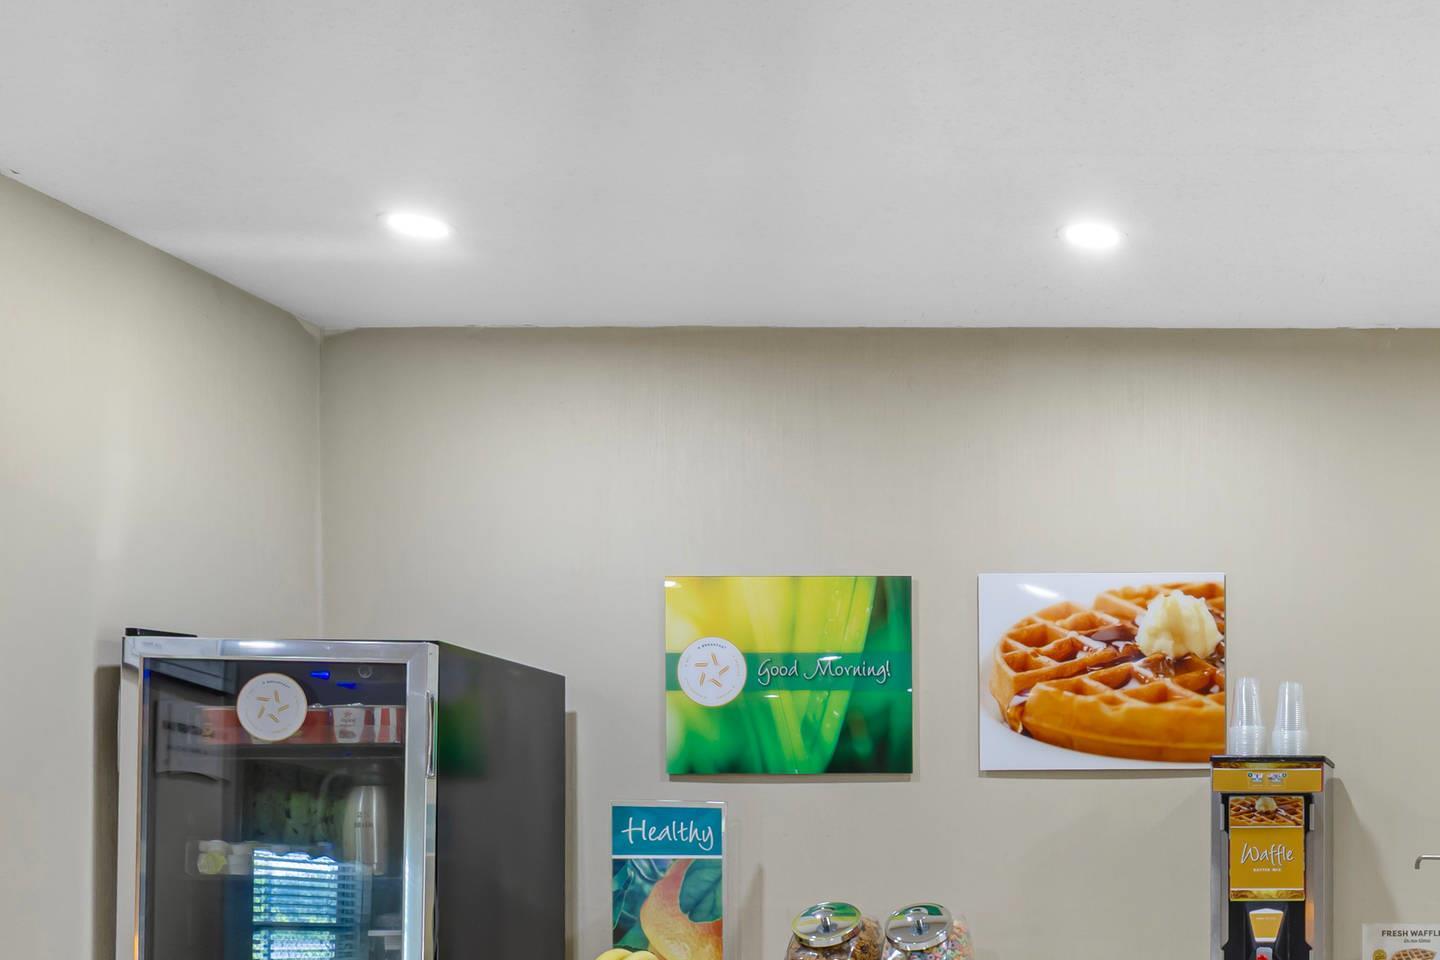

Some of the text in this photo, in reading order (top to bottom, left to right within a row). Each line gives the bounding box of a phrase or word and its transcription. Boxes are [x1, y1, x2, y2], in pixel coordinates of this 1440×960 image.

[757, 658, 891, 686] Good Morning!
[621, 817, 714, 851] Healthy
[1241, 842, 1296, 866] Waffle
